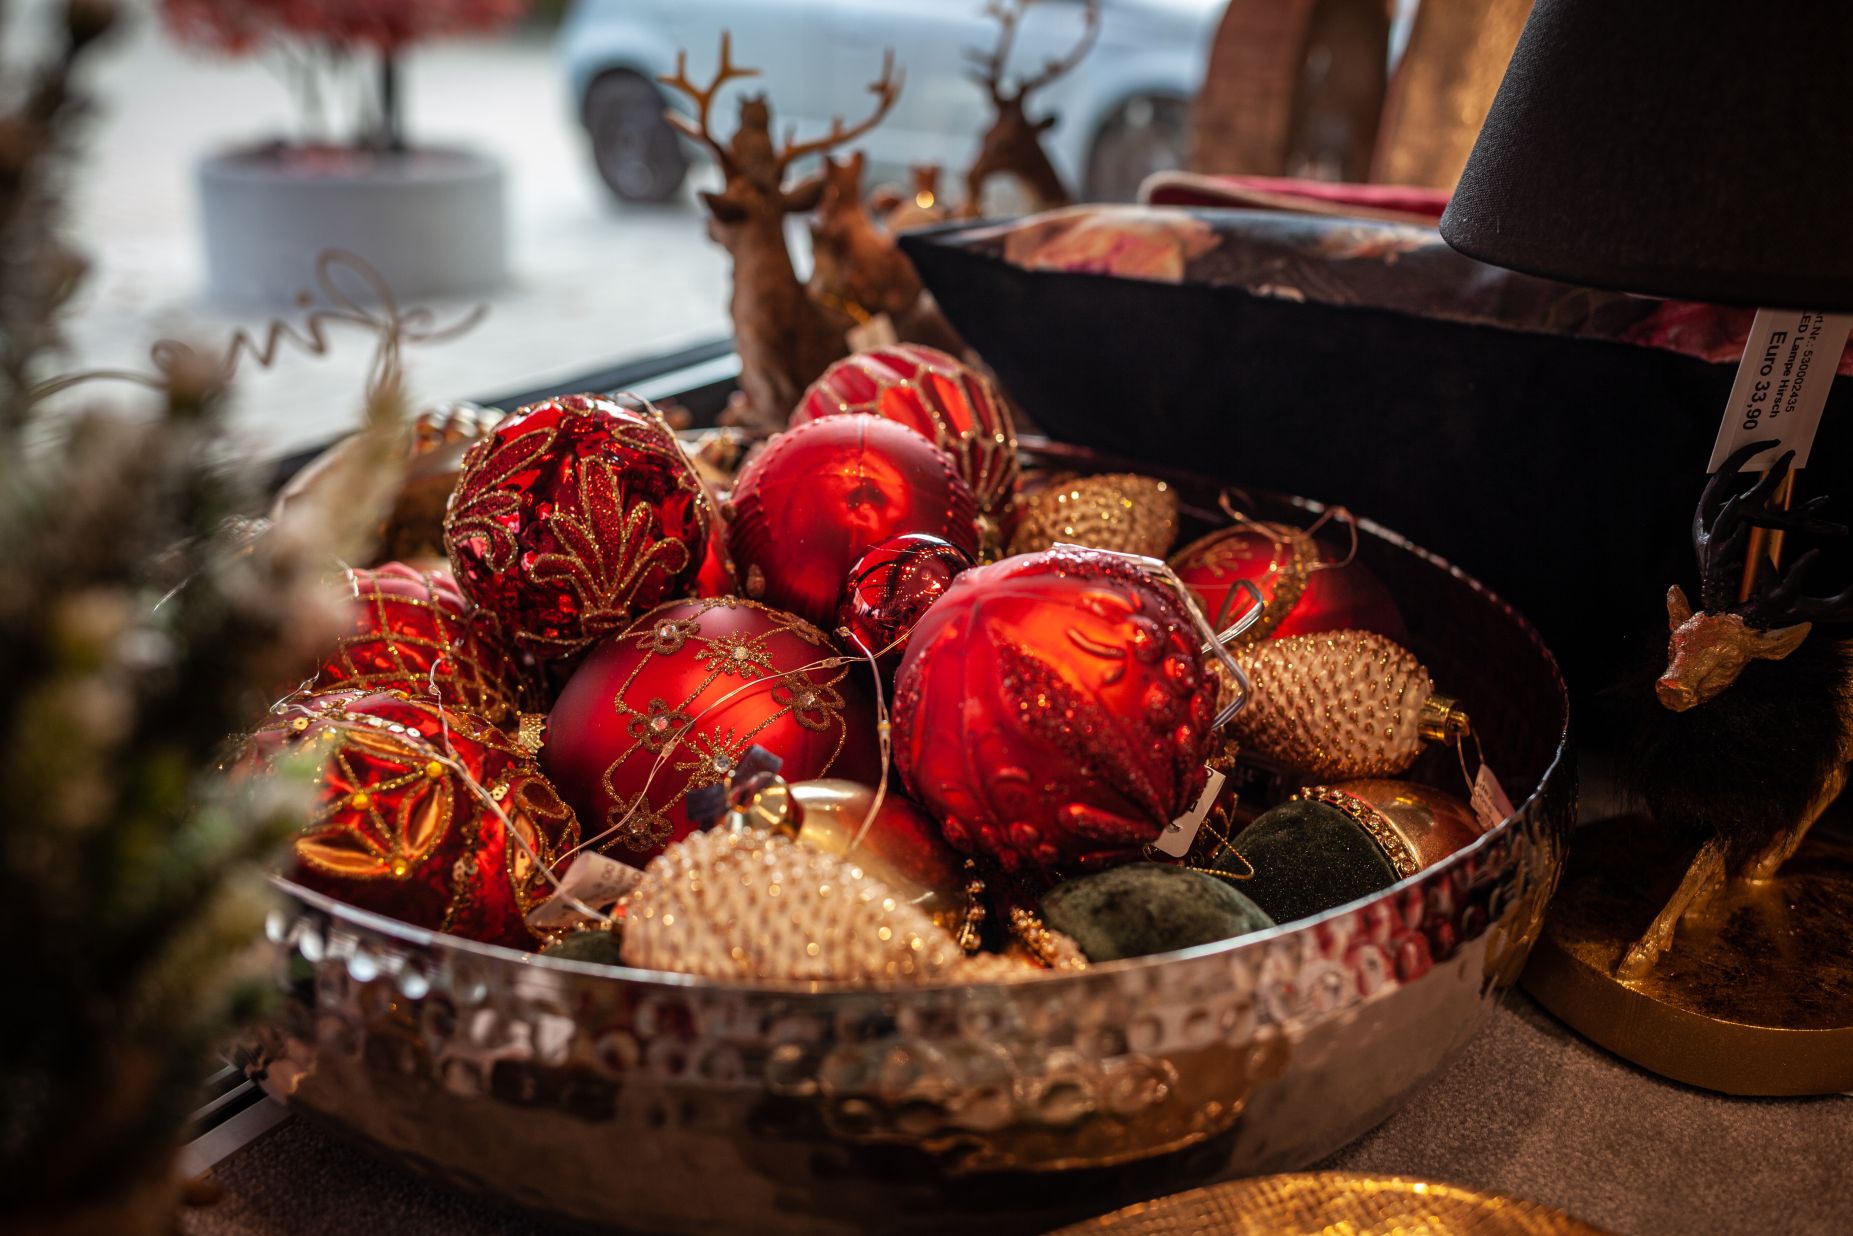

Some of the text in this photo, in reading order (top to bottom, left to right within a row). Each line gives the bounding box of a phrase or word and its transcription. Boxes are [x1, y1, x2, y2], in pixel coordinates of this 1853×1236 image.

[1743, 331, 1788, 430] Euro 33,90
[1782, 336, 1804, 377] Lampe
[1784, 350, 1814, 412] 530002435
[1769, 379, 1789, 418] Hirsch
